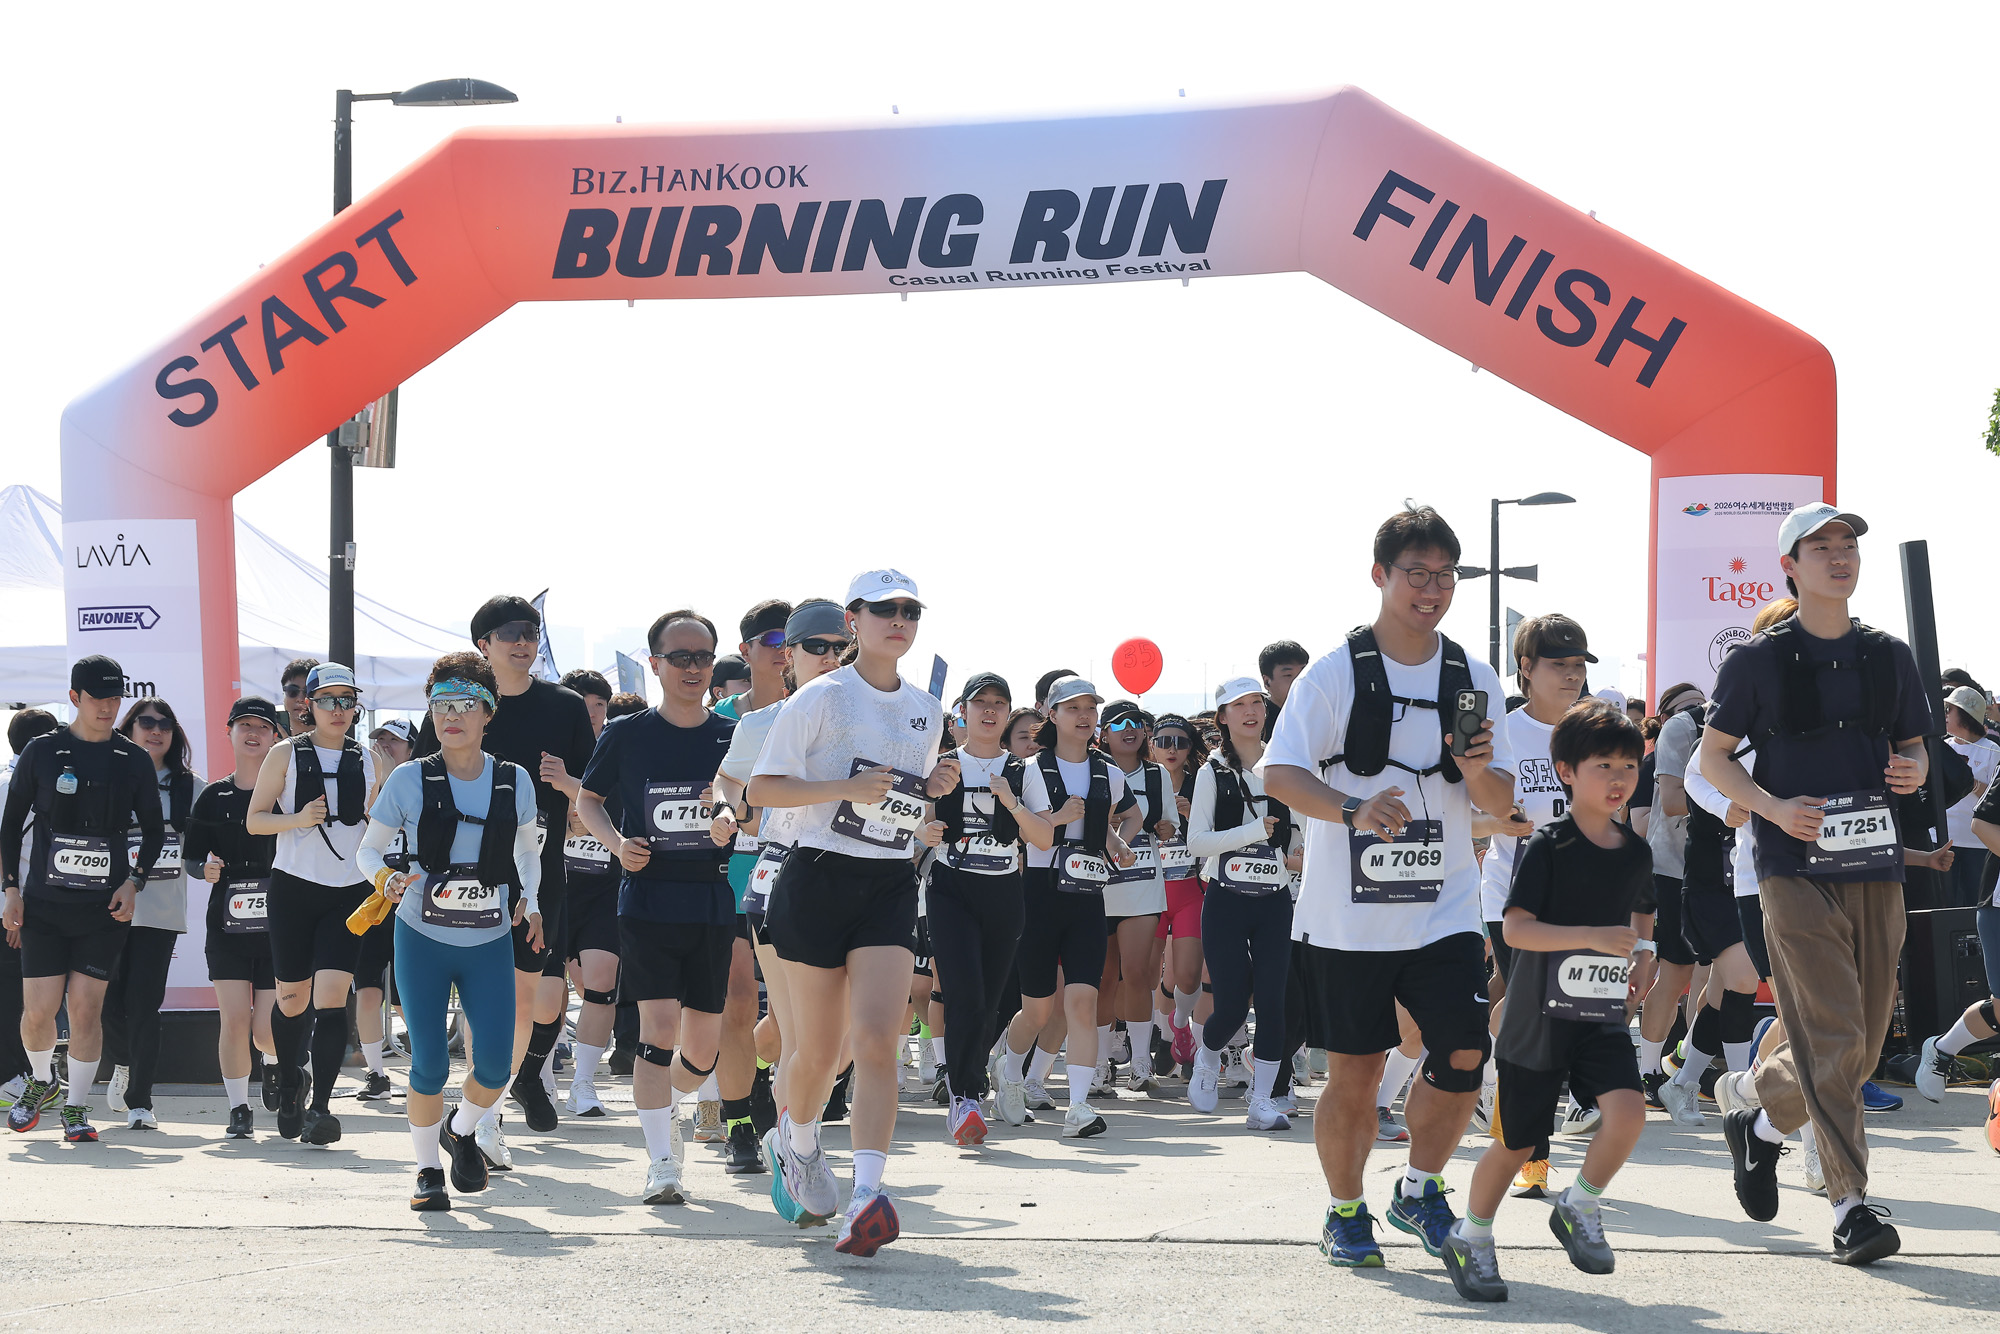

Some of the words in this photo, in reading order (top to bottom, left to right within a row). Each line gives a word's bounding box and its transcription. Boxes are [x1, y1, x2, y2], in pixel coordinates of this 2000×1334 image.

[551, 193, 984, 279] BURNING
[1008, 179, 1229, 264] RUN
[888, 271, 979, 287] Casual
[985, 266, 1100, 283] Running
[1107, 258, 1212, 276] Festival
[1352, 169, 1688, 389] FINISH
[155, 208, 418, 428] START
[1702, 576, 1774, 609] Tage
[82, 611, 146, 626] FAVONEX
[1715, 629, 1752, 646] SUNBOD
[648, 786, 678, 794] BURNING
[880, 796, 922, 820] 7654
[1837, 796, 1853, 806] RUN
[661, 809, 673, 820] M
[678, 805, 710, 820] 710
[1823, 826, 1836, 838] M
[1841, 815, 1888, 836] 7251
[566, 839, 576, 848] M
[60, 855, 70, 864] M
[73, 854, 109, 868] 7090
[1071, 860, 1081, 869] W
[1370, 854, 1384, 867] M
[1390, 849, 1442, 867] 7069
[756, 869, 769, 880] W
[1231, 863, 1241, 872] W
[1244, 862, 1278, 875] 7680
[457, 886, 496, 900] 7831
[233, 901, 243, 909] W
[247, 898, 267, 909] 75
[1568, 967, 1583, 981] M
[1588, 964, 1628, 984] 7068
